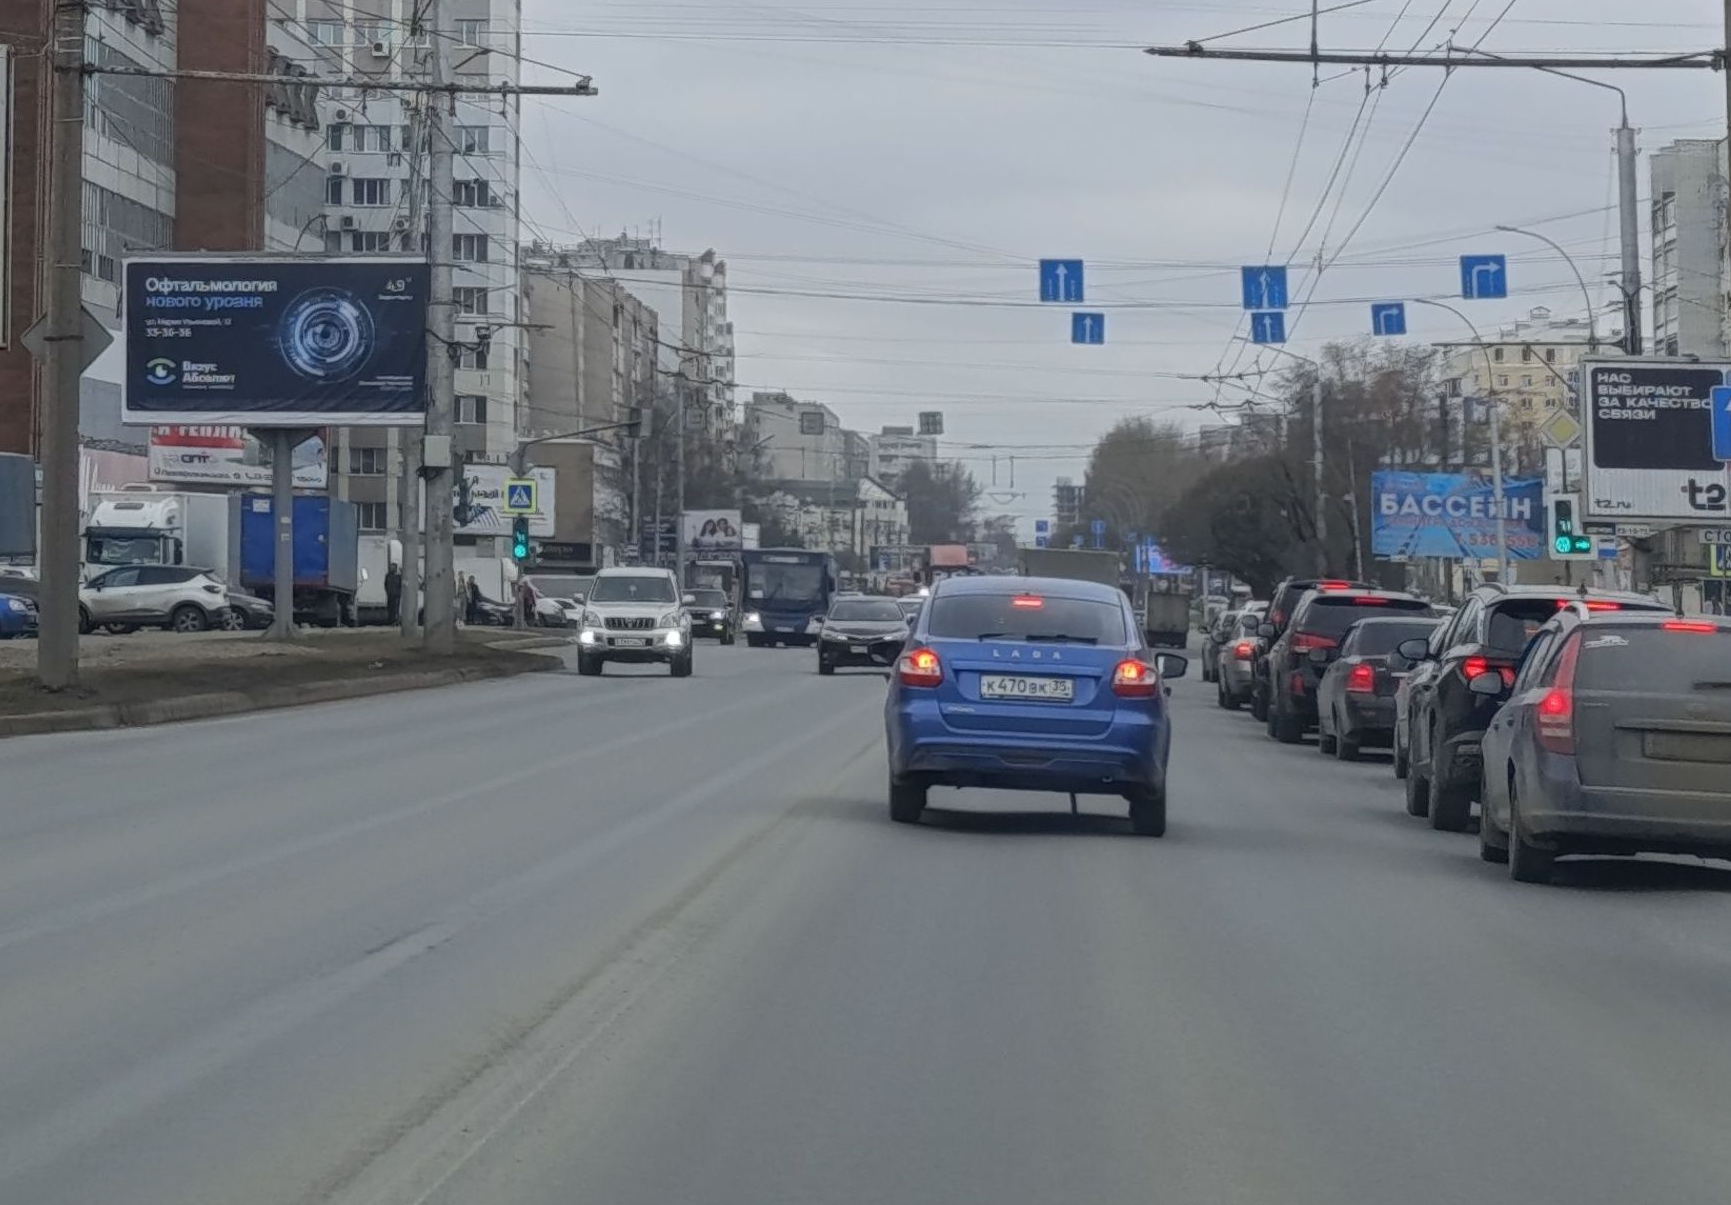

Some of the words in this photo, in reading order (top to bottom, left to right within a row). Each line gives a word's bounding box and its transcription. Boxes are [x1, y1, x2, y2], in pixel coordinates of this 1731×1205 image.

[145, 277, 278, 295] Офтальмология
[145, 296, 202, 308] нового
[204, 296, 264, 311] уровня
[1597, 373, 1632, 384] НАС
[1598, 385, 1693, 397] ВЫБИРАЮТ
[1598, 397, 1621, 408] ЗА
[1626, 398, 1711, 410] КАЧЕСТВО
[1599, 409, 1656, 420] СВЯЗИ
[1680, 478, 1726, 510] t2
[992, 649, 1062, 660] LADA
